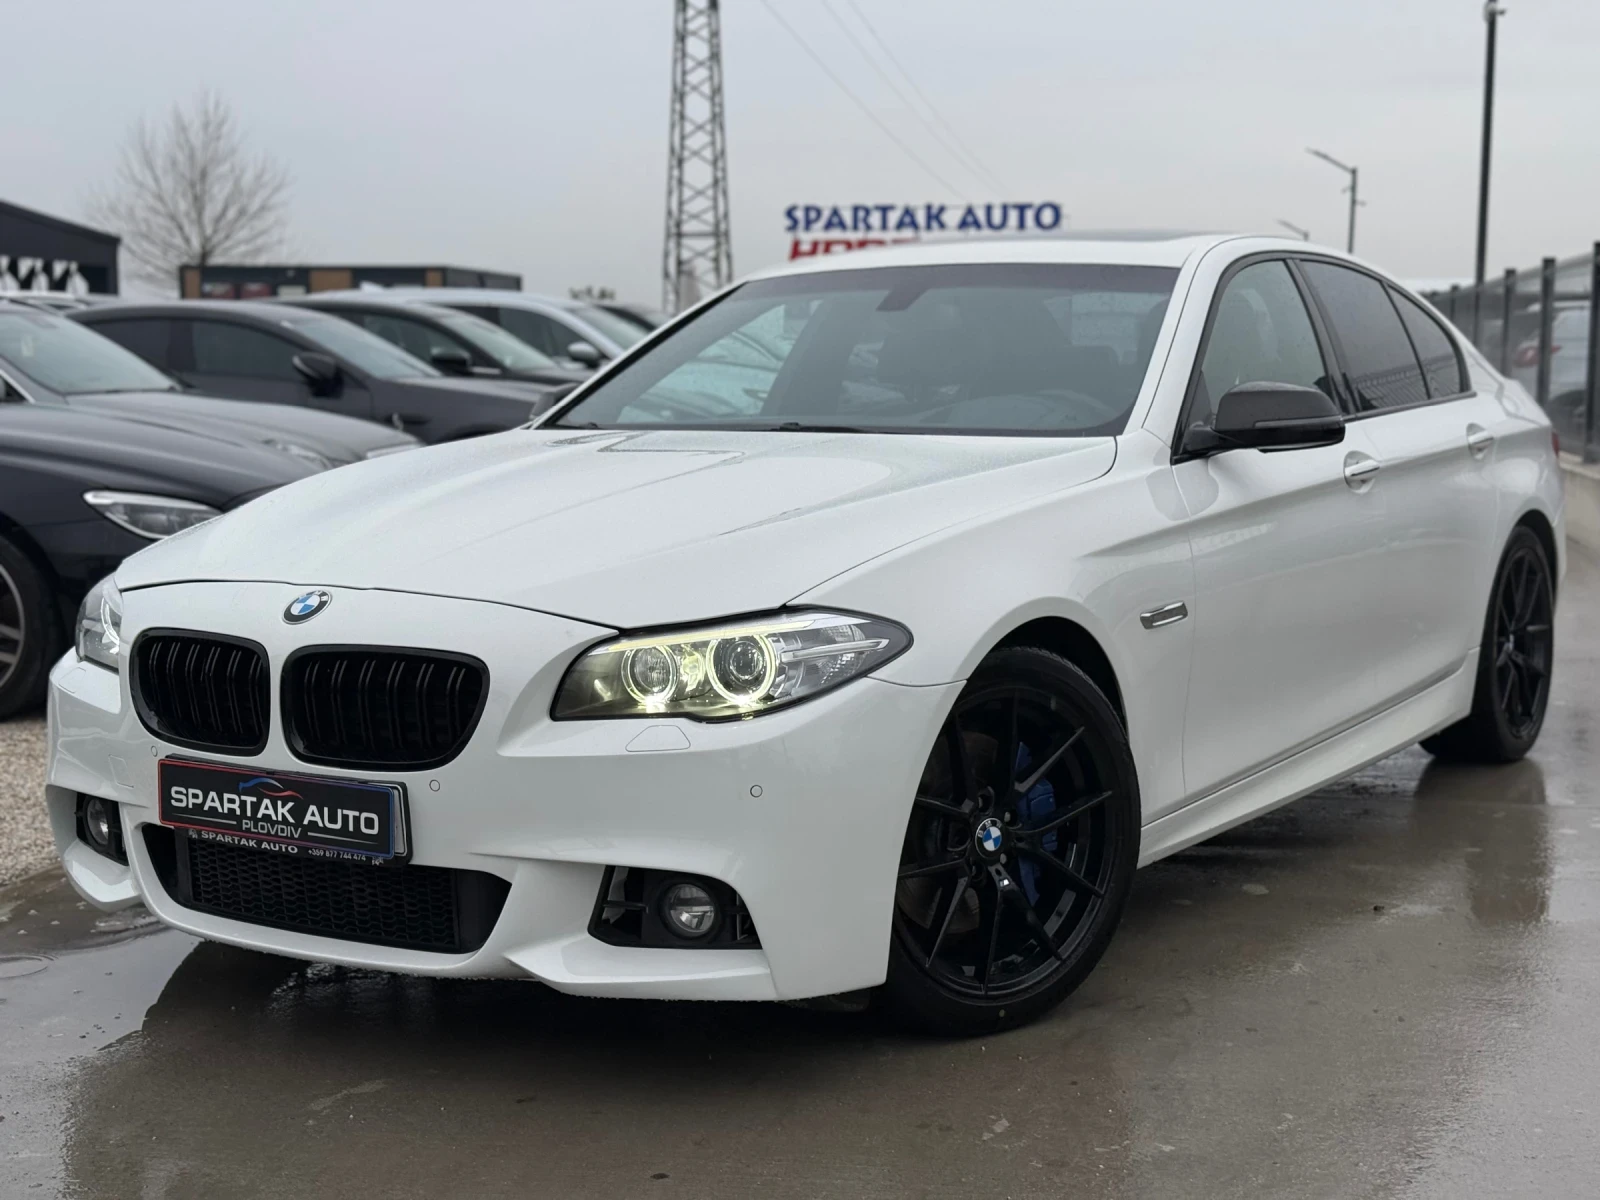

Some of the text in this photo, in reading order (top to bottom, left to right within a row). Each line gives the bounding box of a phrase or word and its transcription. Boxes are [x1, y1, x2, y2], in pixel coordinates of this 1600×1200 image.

[784, 202, 1063, 232] SPARTAK AUTO
[170, 786, 379, 835] SPARTAK AUTO
[242, 820, 302, 838] PLOVDIV
[201, 830, 258, 848] SPARTAK
[261, 841, 299, 854] AUTO
[308, 848, 324, 857] +359
